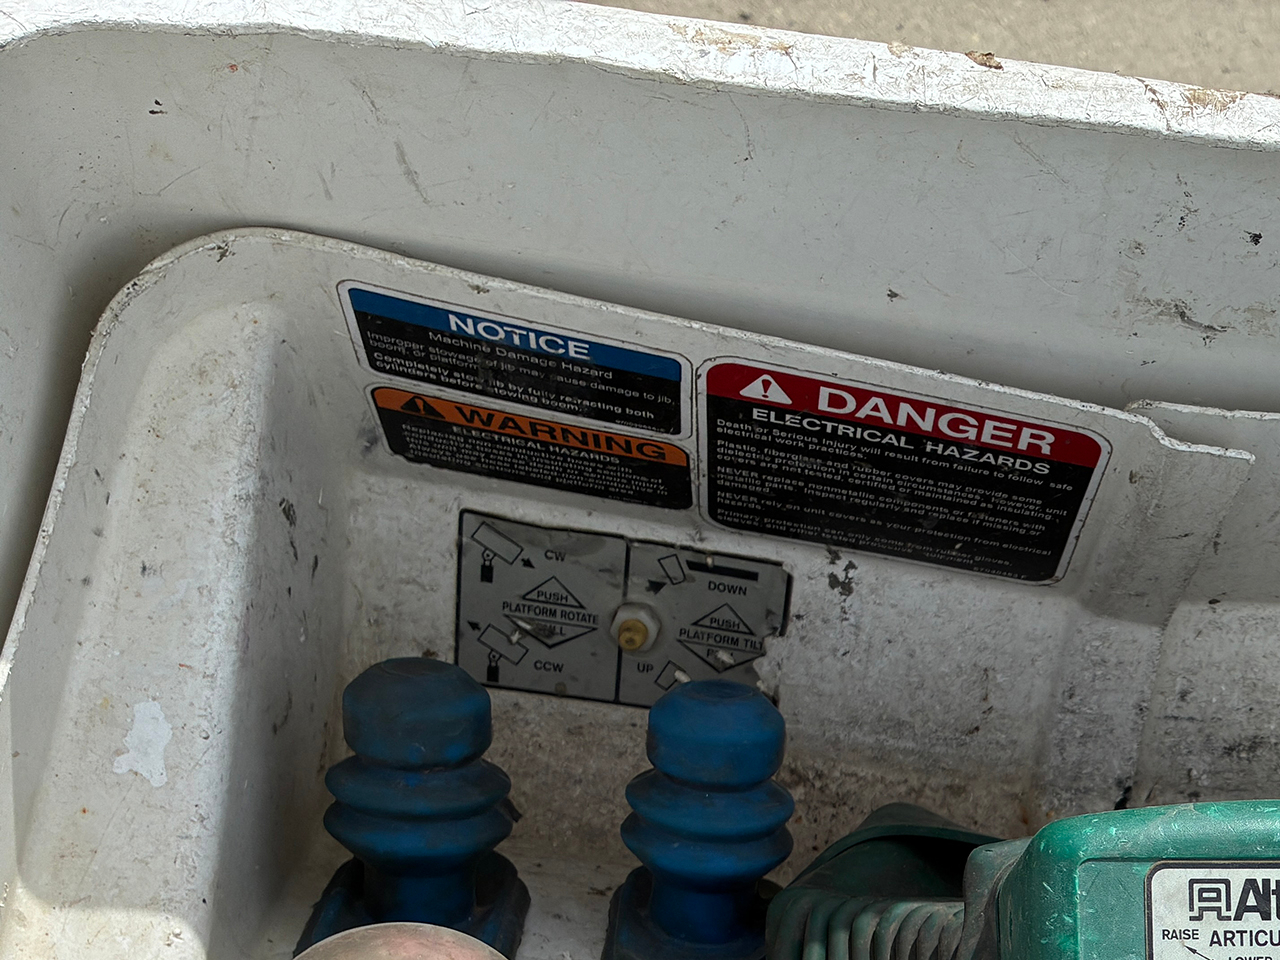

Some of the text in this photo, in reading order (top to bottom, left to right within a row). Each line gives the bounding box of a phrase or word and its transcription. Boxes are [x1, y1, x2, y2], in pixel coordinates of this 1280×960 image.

[429, 331, 612, 379] Machine Damage Hazard
[448, 314, 590, 360] NOTICE
[367, 331, 423, 351] Improper
[590, 381, 638, 398] damage
[643, 392, 653, 400] to
[373, 351, 449, 375] Completely
[508, 383, 523, 392] by
[626, 406, 653, 418] both
[455, 405, 664, 461] WARNING
[717, 426, 866, 460] electrical work practices.
[753, 407, 1050, 475] ELECTRICAL HAZARDS
[818, 385, 1056, 455] DANGER
[717, 418, 1072, 491] Death or Serious Injury will result from failure to follow safe
[717, 453, 755, 466] covers
[760, 461, 777, 470] are
[782, 465, 800, 474] not
[848, 477, 894, 491] certified
[899, 486, 910, 494] or
[914, 489, 976, 506] maintained
[980, 501, 993, 509] as
[717, 465, 757, 479] NEVER
[762, 473, 804, 487] replace
[808, 482, 874, 500] nonmetallic
[1022, 521, 1045, 531] with
[827, 459, 847, 469] and
[852, 464, 891, 477] rubber
[895, 472, 933, 485] covers
[937, 480, 961, 490] may
[1011, 494, 1042, 505] some
[853, 471, 896, 485] certain
[1045, 507, 1067, 516] unit
[717, 490, 756, 503] NEVER
[762, 498, 781, 508] rely
[804, 506, 824, 515] unit
[973, 537, 999, 546] from
[804, 487, 845, 500] Inspect
[850, 496, 900, 511] regularly
[903, 506, 924, 516] and
[982, 520, 1025, 534] missing
[544, 550, 566, 562] CW
[536, 590, 568, 603] PUSH
[708, 581, 747, 596] DOWN
[502, 601, 599, 625] PLATFORM ROTATE
[709, 616, 741, 631] PUSH
[679, 628, 765, 651] PLATFORM TILT
[534, 660, 564, 673] CCW
[637, 662, 654, 674] UP
[1162, 929, 1199, 940] RAISE
